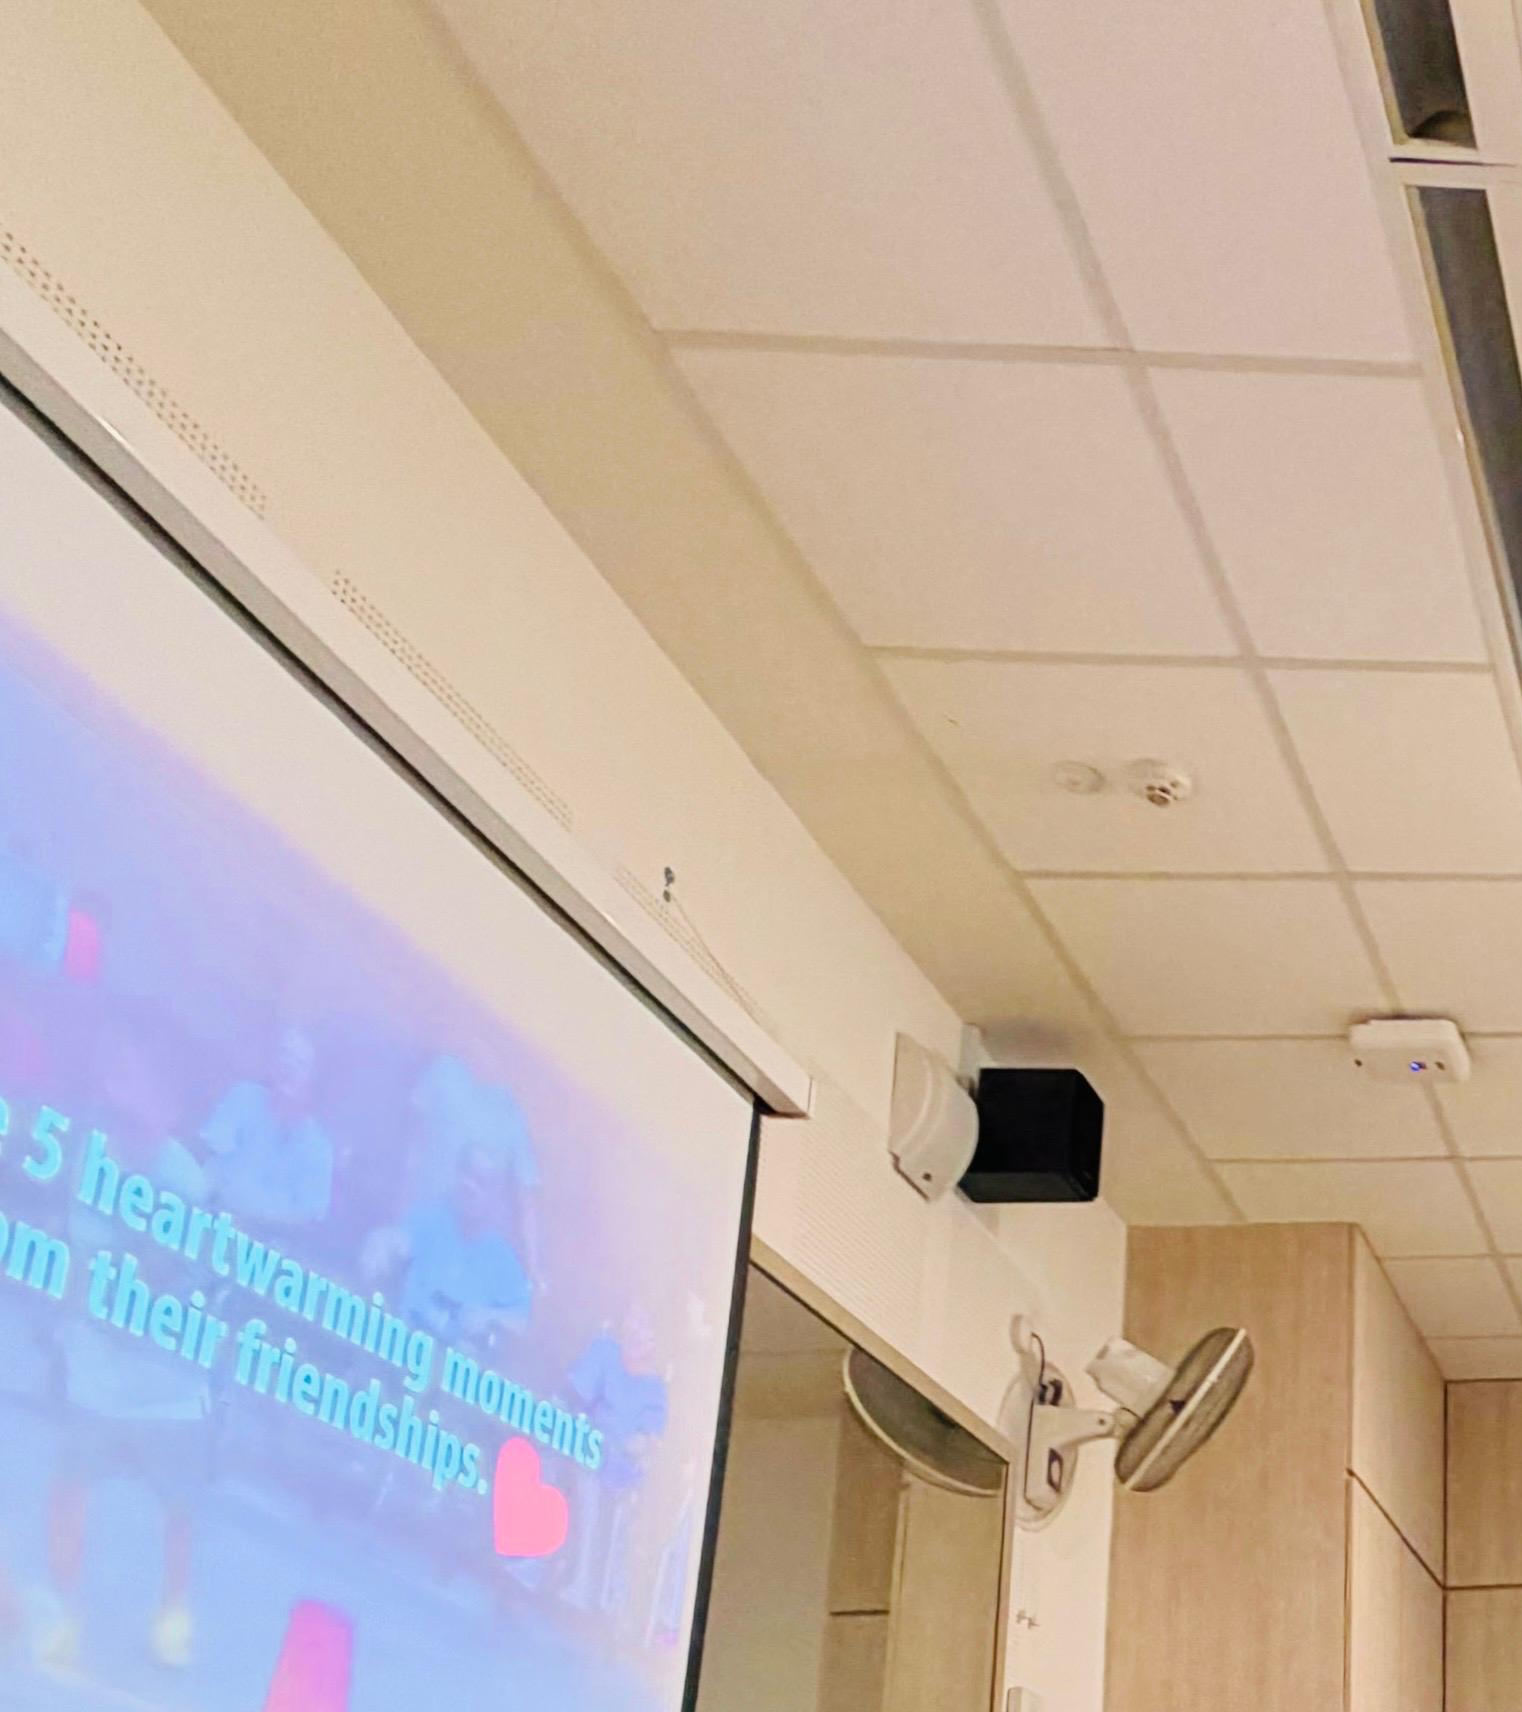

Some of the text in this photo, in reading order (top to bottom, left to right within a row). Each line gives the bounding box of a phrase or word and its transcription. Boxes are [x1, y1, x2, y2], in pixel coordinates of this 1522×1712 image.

[22, 1104, 70, 1181] 5
[76, 1128, 434, 1393] heartwarming
[441, 1346, 604, 1471] moments
[89, 1250, 228, 1369] their
[235, 1318, 488, 1495] friendships.
